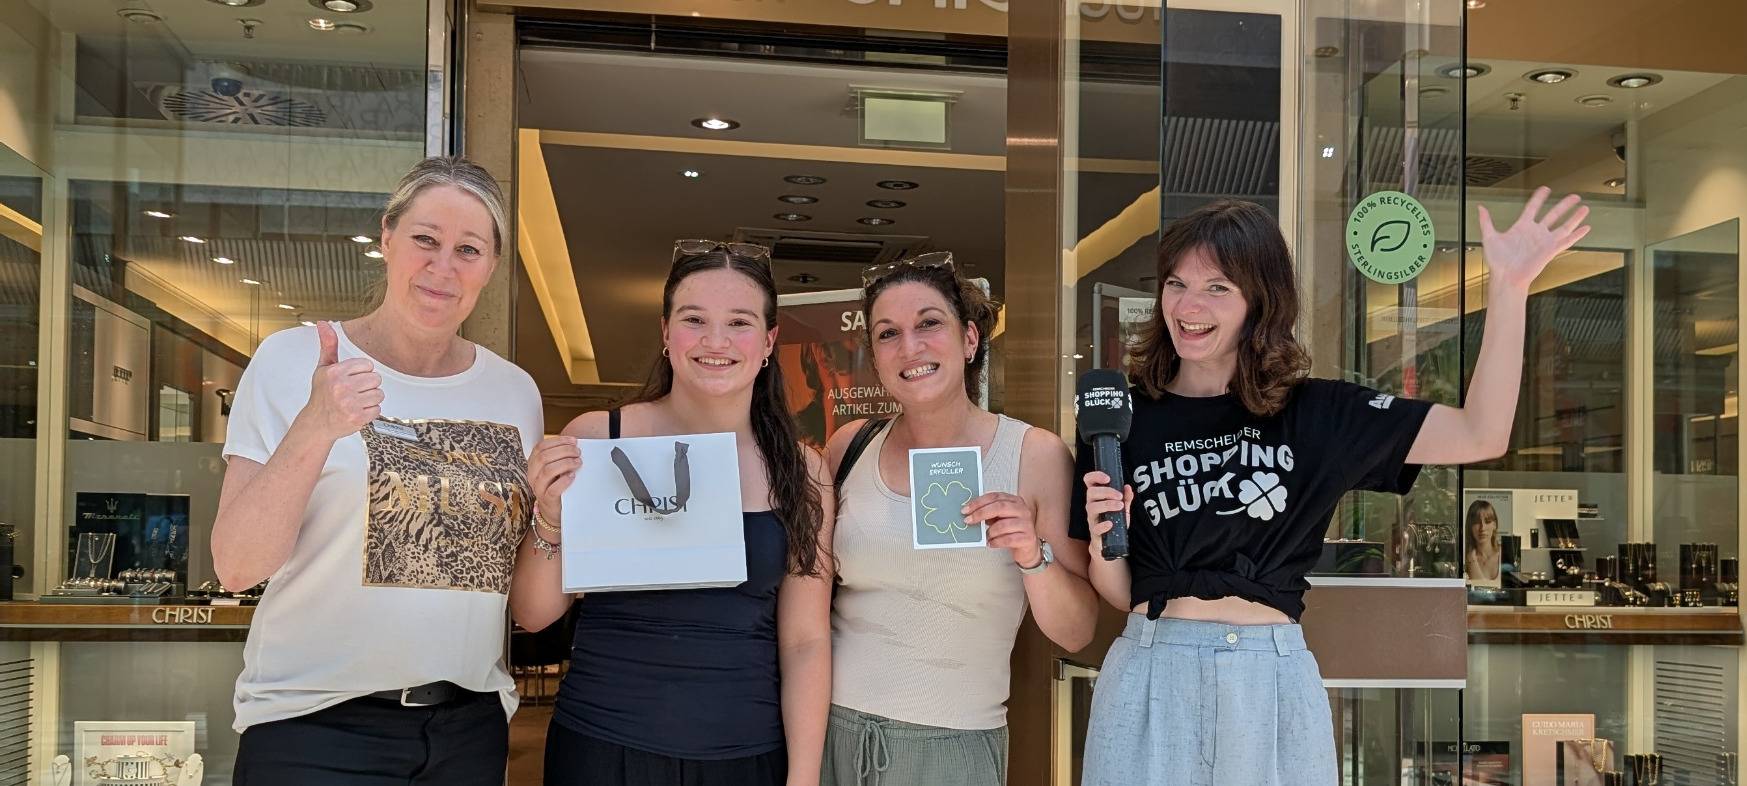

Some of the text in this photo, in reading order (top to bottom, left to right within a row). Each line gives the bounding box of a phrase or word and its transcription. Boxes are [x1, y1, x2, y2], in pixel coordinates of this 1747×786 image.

[1353, 196, 1431, 236] 100% RECYCELTES
[1351, 243, 1427, 280] STERLINGSILBER
[840, 310, 867, 332] SA
[827, 384, 892, 400] AUSGEWÄH
[1084, 390, 1124, 399] SHOPPING
[831, 401, 903, 416] ARTIKEL ZUM
[1084, 398, 1112, 407] GLÜCK
[1534, 494, 1566, 503] JETTE
[1539, 592, 1575, 602] JETTE
[151, 607, 216, 624] CHRIST
[1564, 613, 1614, 629] CHRIST
[127, 735, 136, 746] UP
[137, 735, 155, 746] YOUR
[155, 735, 168, 746] LIFE
